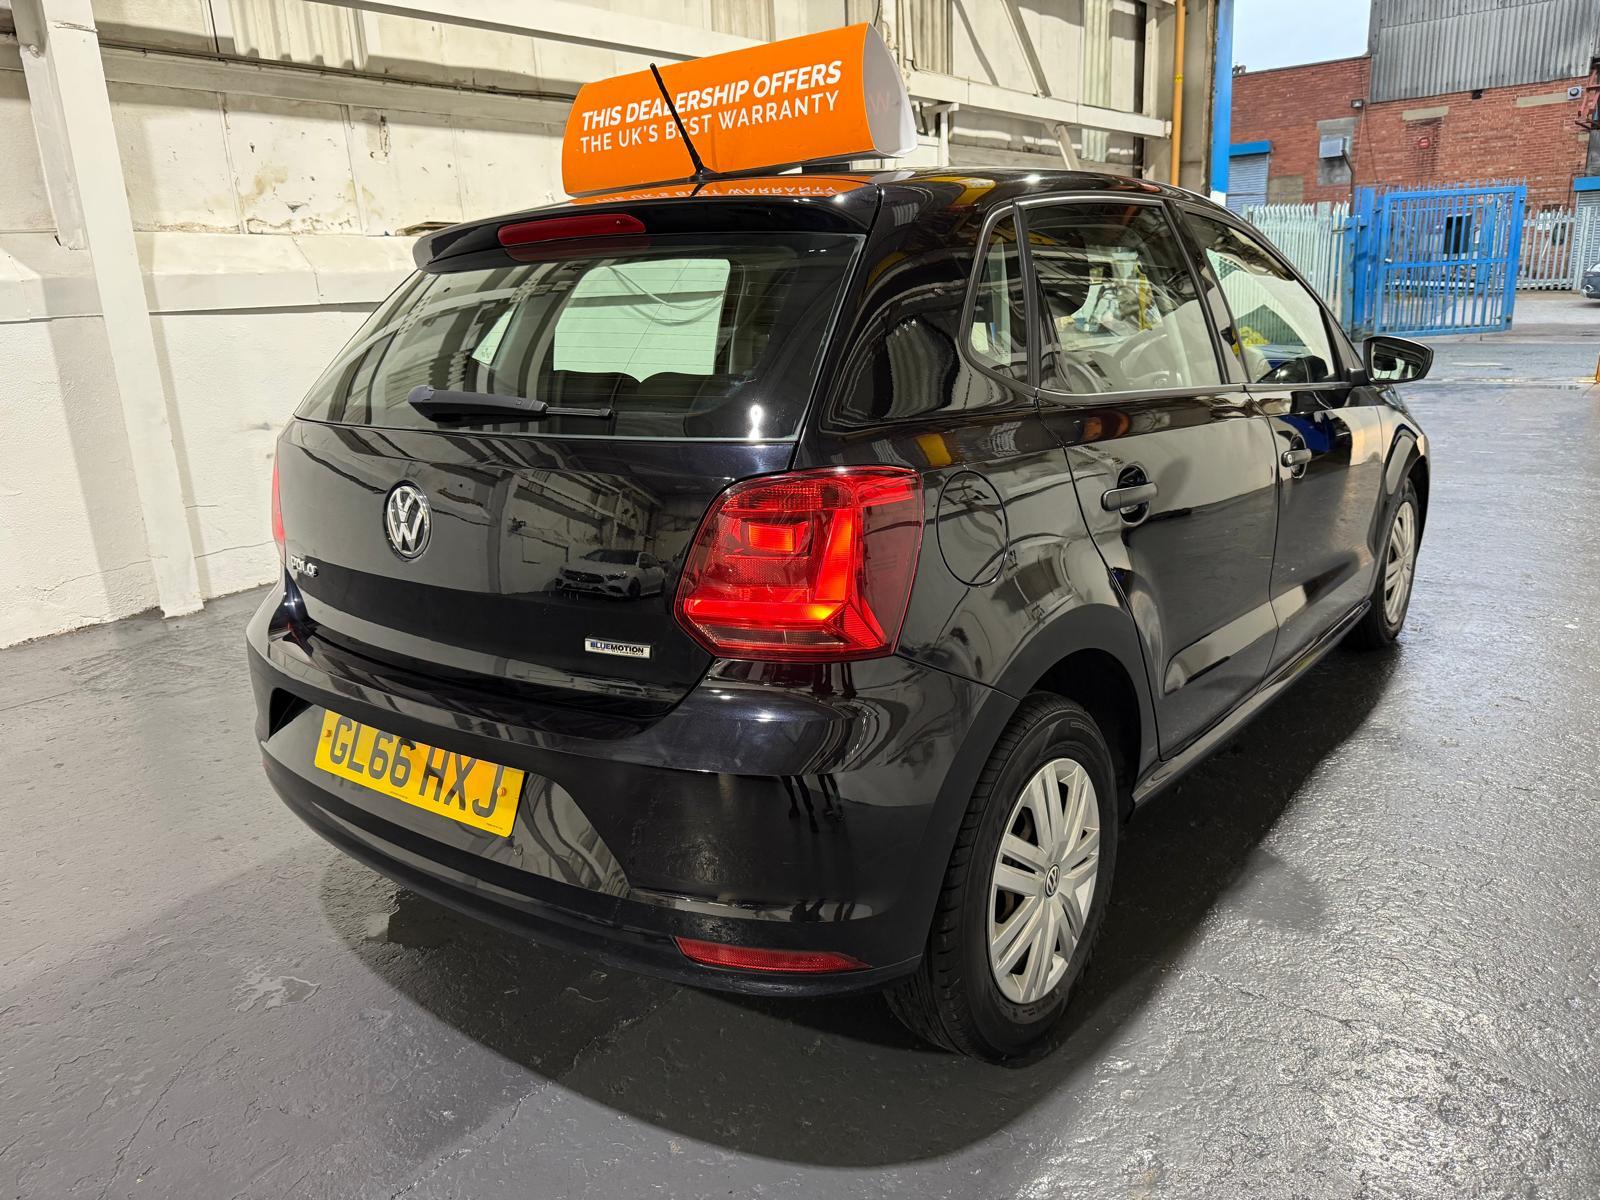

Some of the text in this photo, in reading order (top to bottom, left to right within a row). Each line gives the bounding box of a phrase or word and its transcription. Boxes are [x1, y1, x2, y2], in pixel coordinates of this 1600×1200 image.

[580, 133, 612, 154] THE
[619, 124, 658, 147] UK'S
[718, 90, 839, 130] WARRANTY
[582, 60, 842, 131] THIS DEALERSHIP OFFERS
[591, 641, 644, 653] BLUEMOTION
[329, 715, 505, 818] GL66 HXJ
